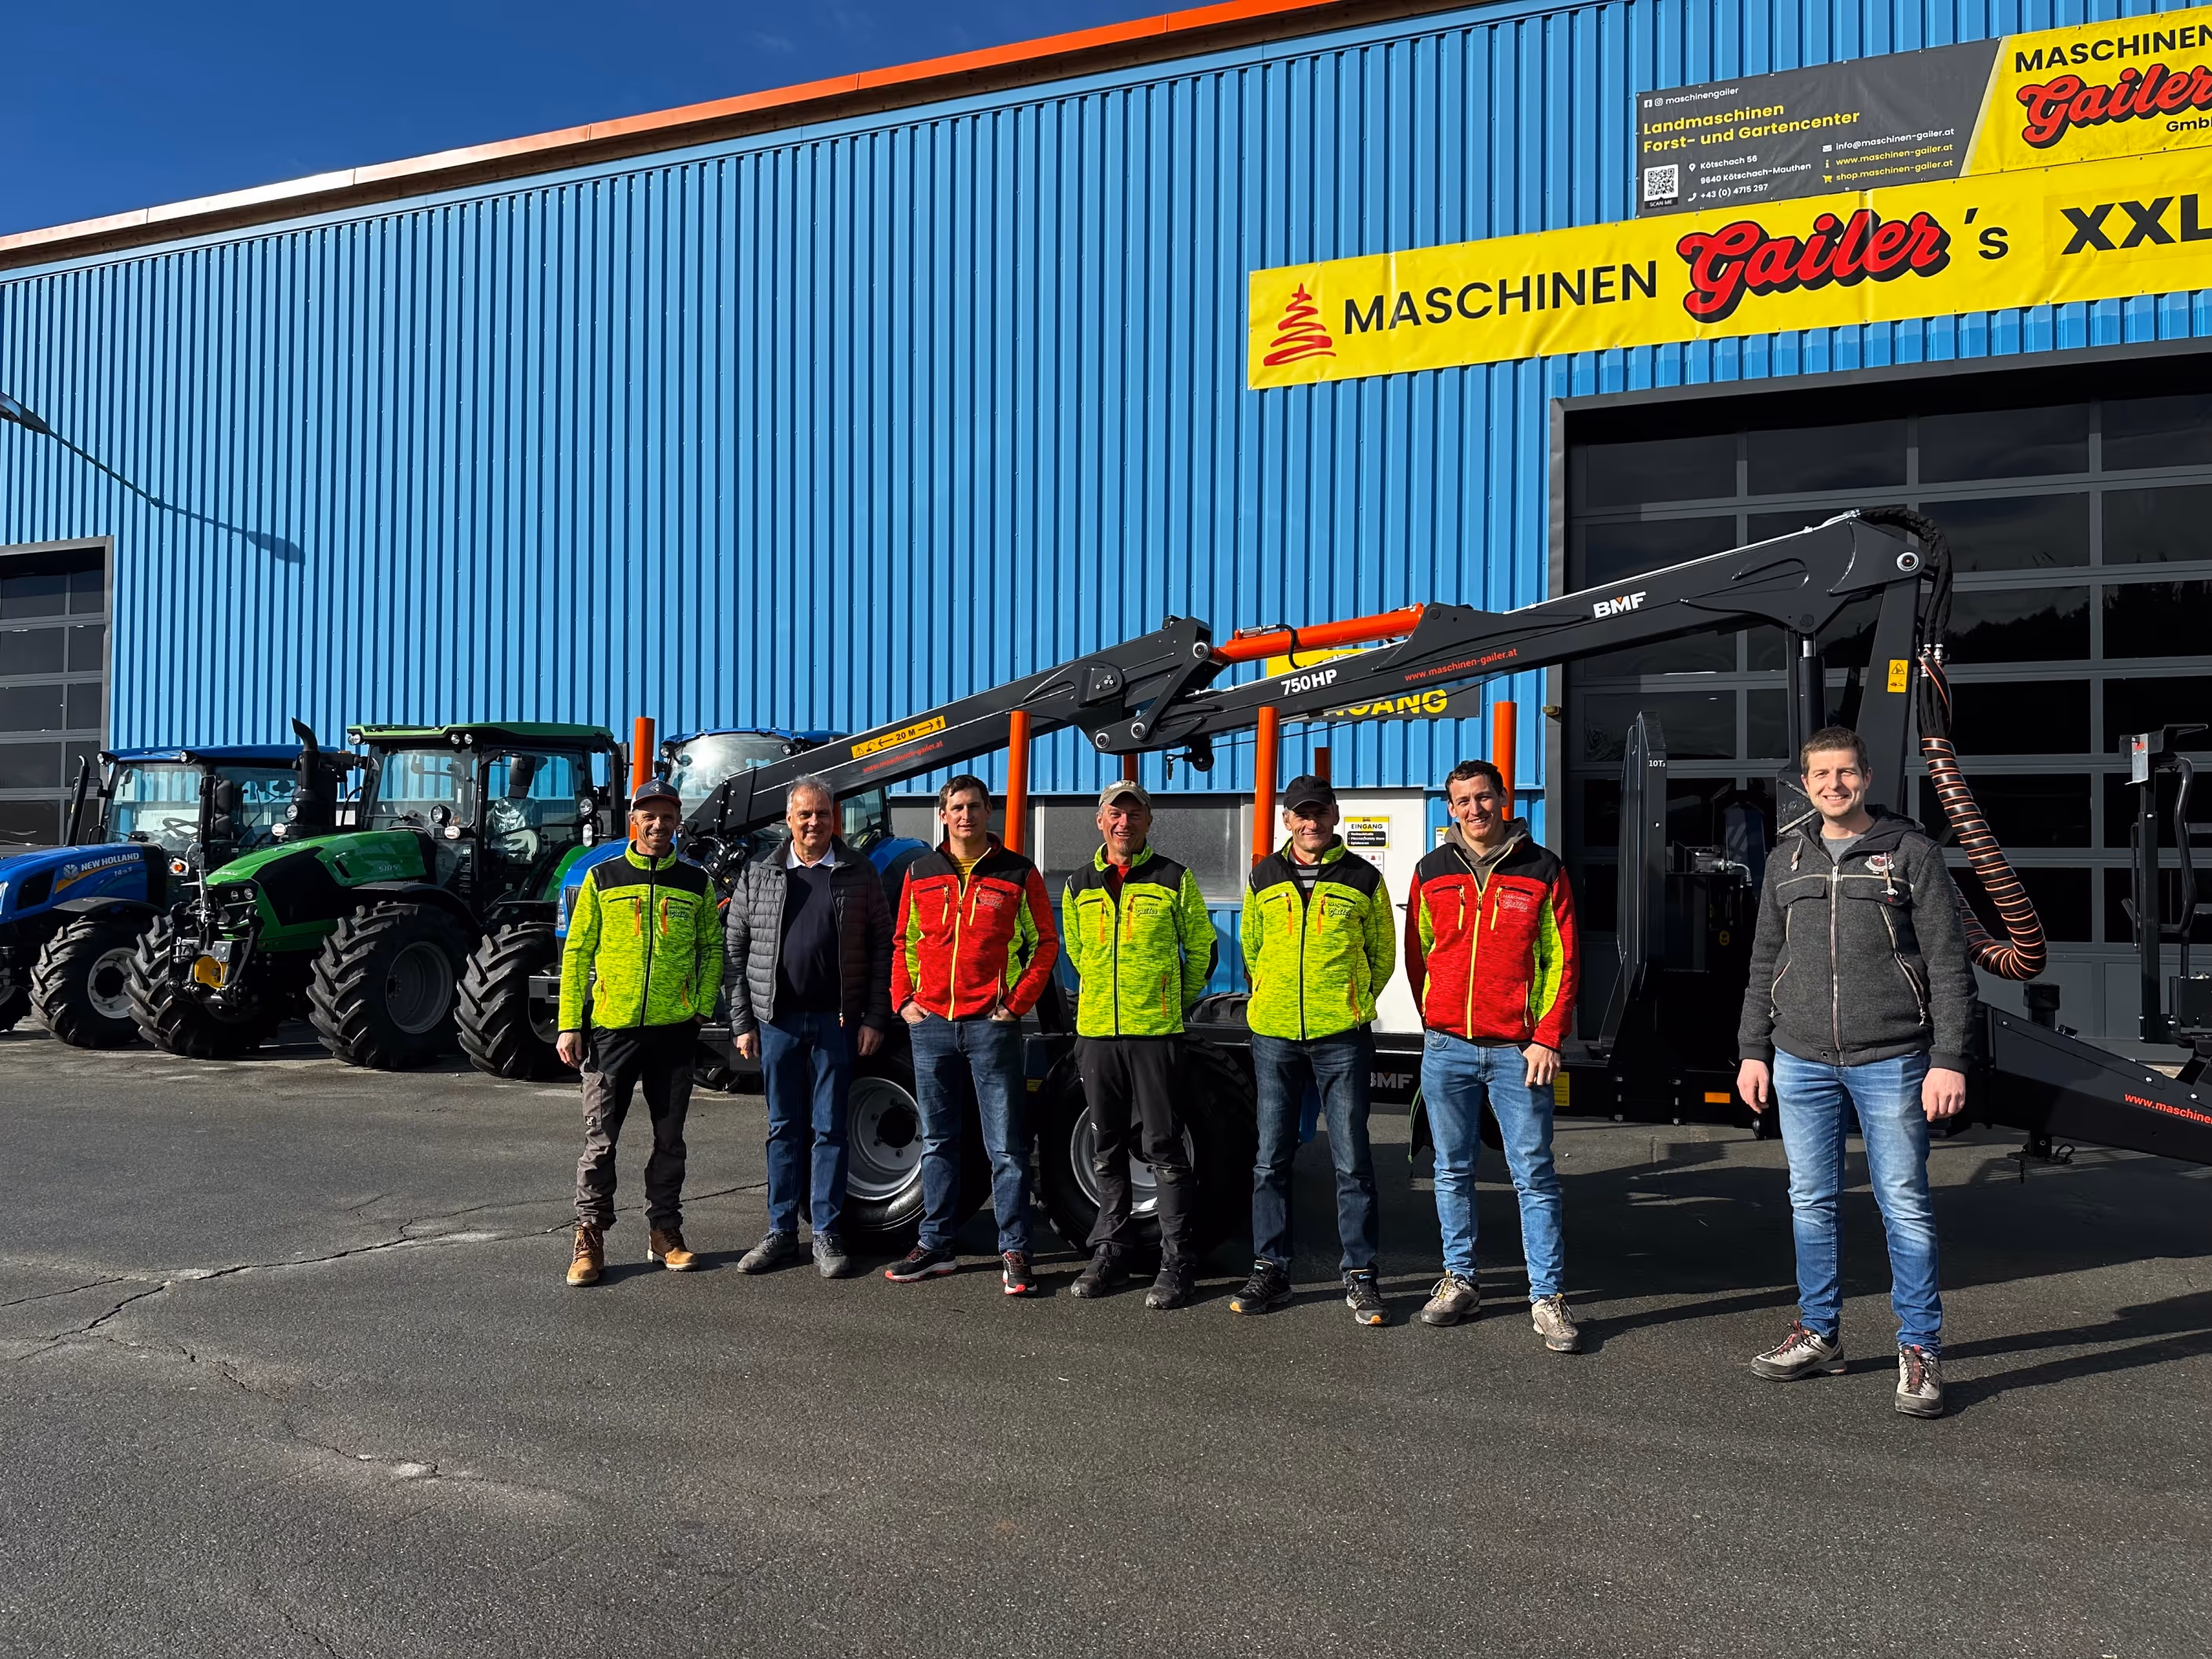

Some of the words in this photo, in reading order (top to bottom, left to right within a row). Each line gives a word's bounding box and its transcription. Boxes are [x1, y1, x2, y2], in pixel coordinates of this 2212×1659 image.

[2015, 24, 2212, 73] MASCHINEN
[1666, 88, 1739, 104] maschinengailer
[2016, 63, 2212, 149] Gailer
[1643, 104, 1785, 135] Landmaschinen
[2166, 117, 2212, 133] Gmb
[1643, 136, 1695, 154] Forst-
[1700, 128, 1734, 144] und
[1738, 111, 1860, 139] Gartencenter
[1836, 128, 1955, 151] info@maschinen-gailer.at
[1700, 156, 1745, 170] Kötschach
[1746, 154, 1757, 163] 56
[1835, 143, 1953, 166] www.maschinen-gailer.at
[1700, 175, 1722, 184] 9640
[1723, 162, 1811, 182] Kötschach-Mauthen
[1835, 159, 1953, 183] shop.maschinen-gailer.at
[1700, 189, 1717, 199] +43
[1718, 187, 1732, 198] (0)
[1733, 185, 1751, 195] 4715
[1753, 183, 1768, 193] 297
[1344, 260, 1656, 335] MASCHINEN
[1676, 209, 1952, 324] Gailer
[2059, 192, 2212, 256] XXL
[1593, 590, 1647, 619] BMF
[1404, 648, 1518, 682] www.maschinen-gailer.at
[895, 731, 906, 742] 20
[908, 728, 916, 737] M
[81, 859, 100, 872] NEW
[101, 852, 140, 866] HOLLAND
[1369, 1071, 1414, 1089] BMF
[2124, 1094, 2212, 1125] www.maschine
